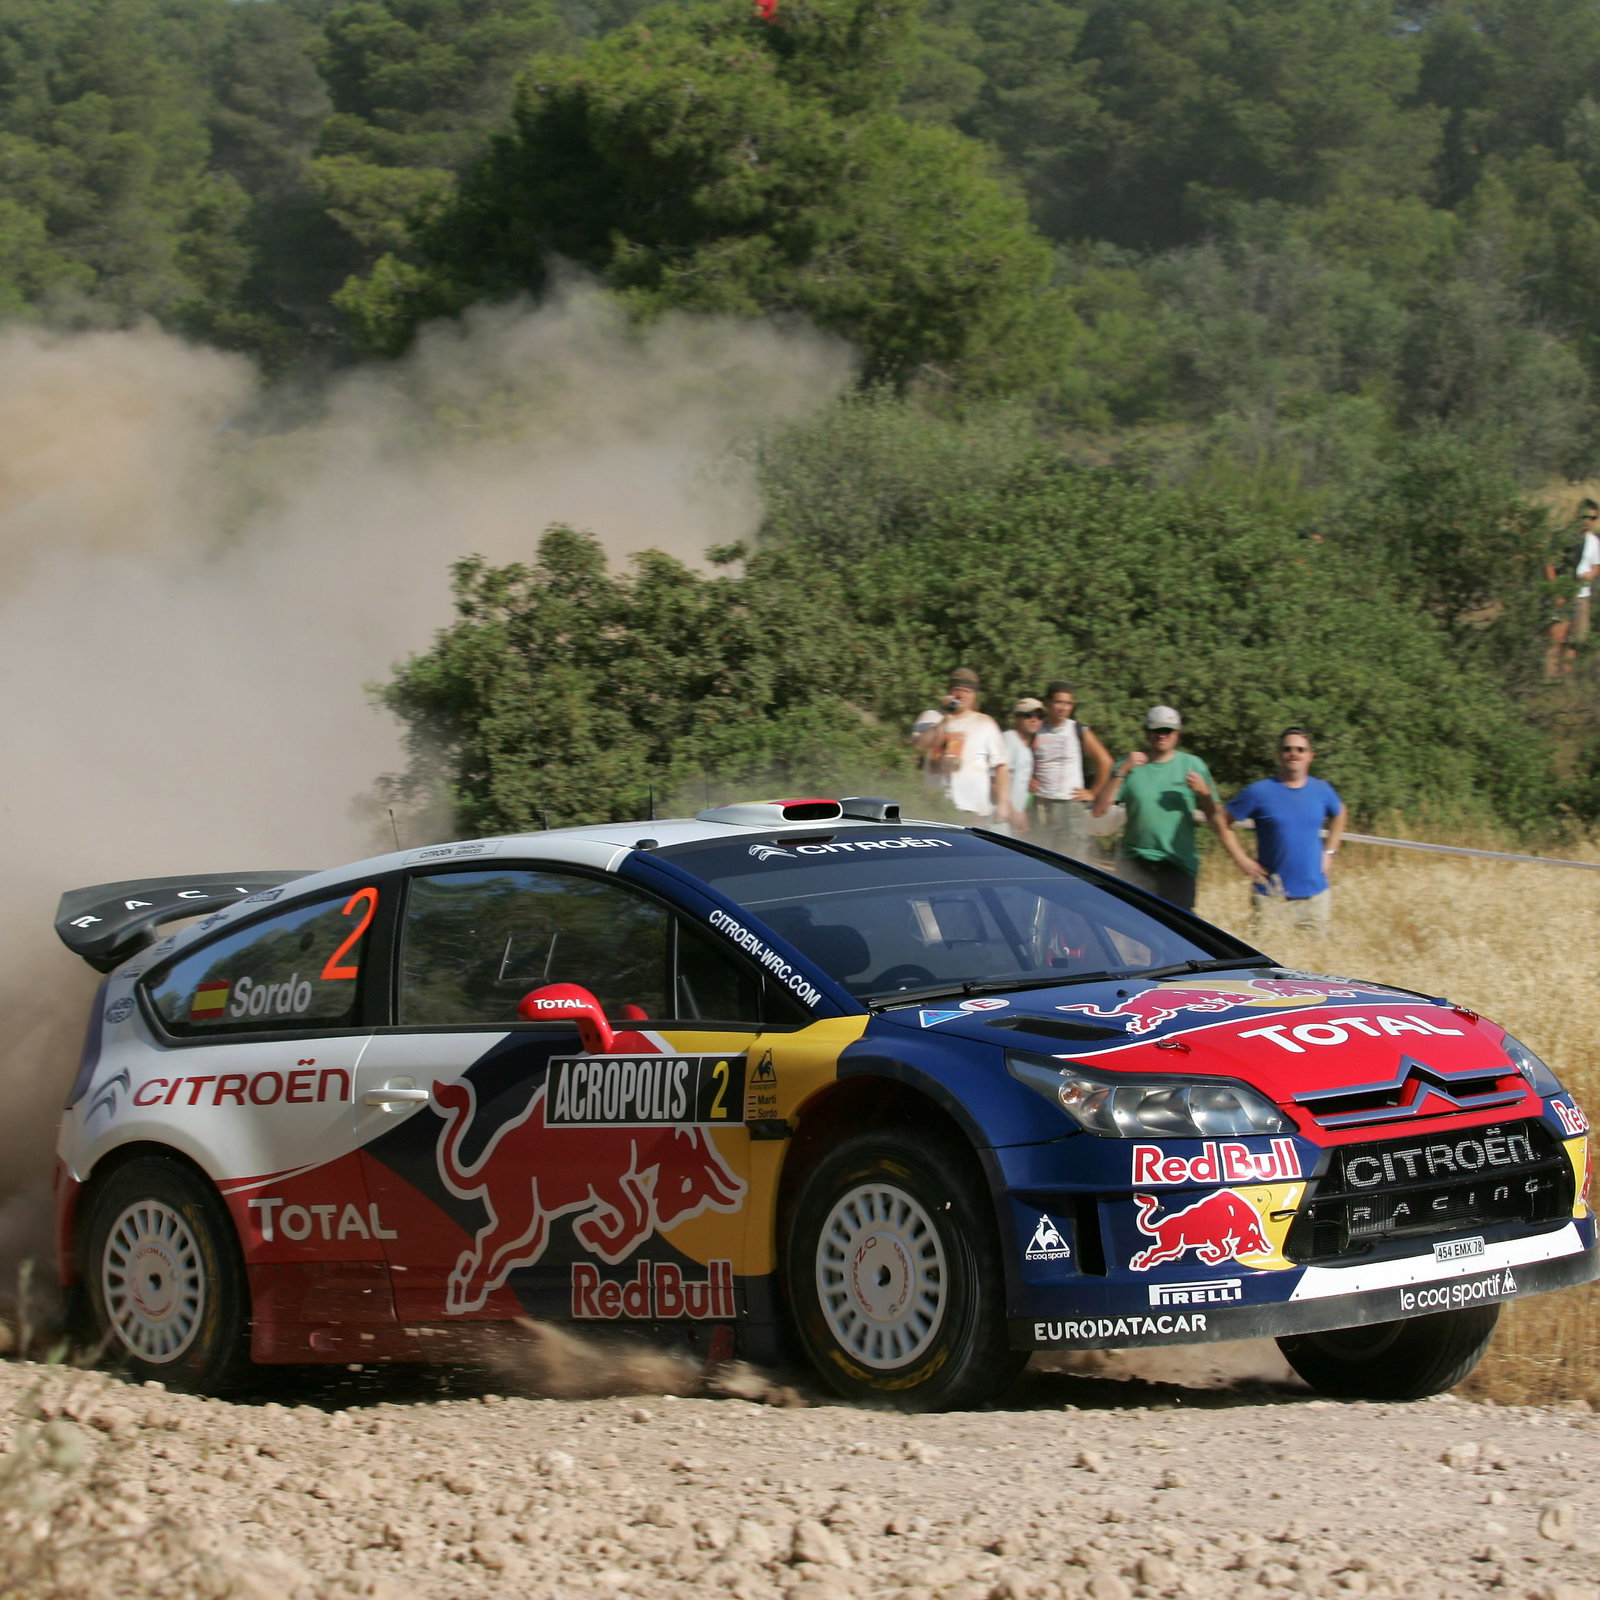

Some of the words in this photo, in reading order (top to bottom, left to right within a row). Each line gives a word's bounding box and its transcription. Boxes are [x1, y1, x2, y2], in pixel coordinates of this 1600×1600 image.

[796, 836, 953, 855] CITROËN
[69, 886, 249, 929] RACI
[320, 886, 379, 980] 2
[708, 910, 822, 1009] CITROEN-WRC.COM
[229, 972, 312, 1018] Sordo
[533, 998, 586, 1010] TOTAL
[967, 999, 1003, 1009] E
[1239, 1014, 1465, 1054] TOTAL
[132, 1058, 351, 1107] CITROËN
[554, 1060, 690, 1122] ACROPOLIS
[709, 1060, 731, 1119] 2
[1131, 1141, 1220, 1186] Red
[1219, 1137, 1303, 1182] Bull
[1346, 1127, 1536, 1188] CITROËN
[247, 1197, 398, 1242] TOTAL
[1352, 1177, 1540, 1221] RACING
[1437, 1246, 1453, 1259] 454
[1454, 1241, 1473, 1256] EMX
[1473, 1239, 1483, 1254] 78
[571, 1259, 652, 1320] Red
[653, 1258, 738, 1319] Bull
[1148, 1278, 1243, 1306] PIRELLI
[1400, 1288, 1416, 1311] le
[1417, 1286, 1450, 1309] coq
[1451, 1273, 1501, 1307] sportif
[1034, 1313, 1207, 1341] EURODATACAR
